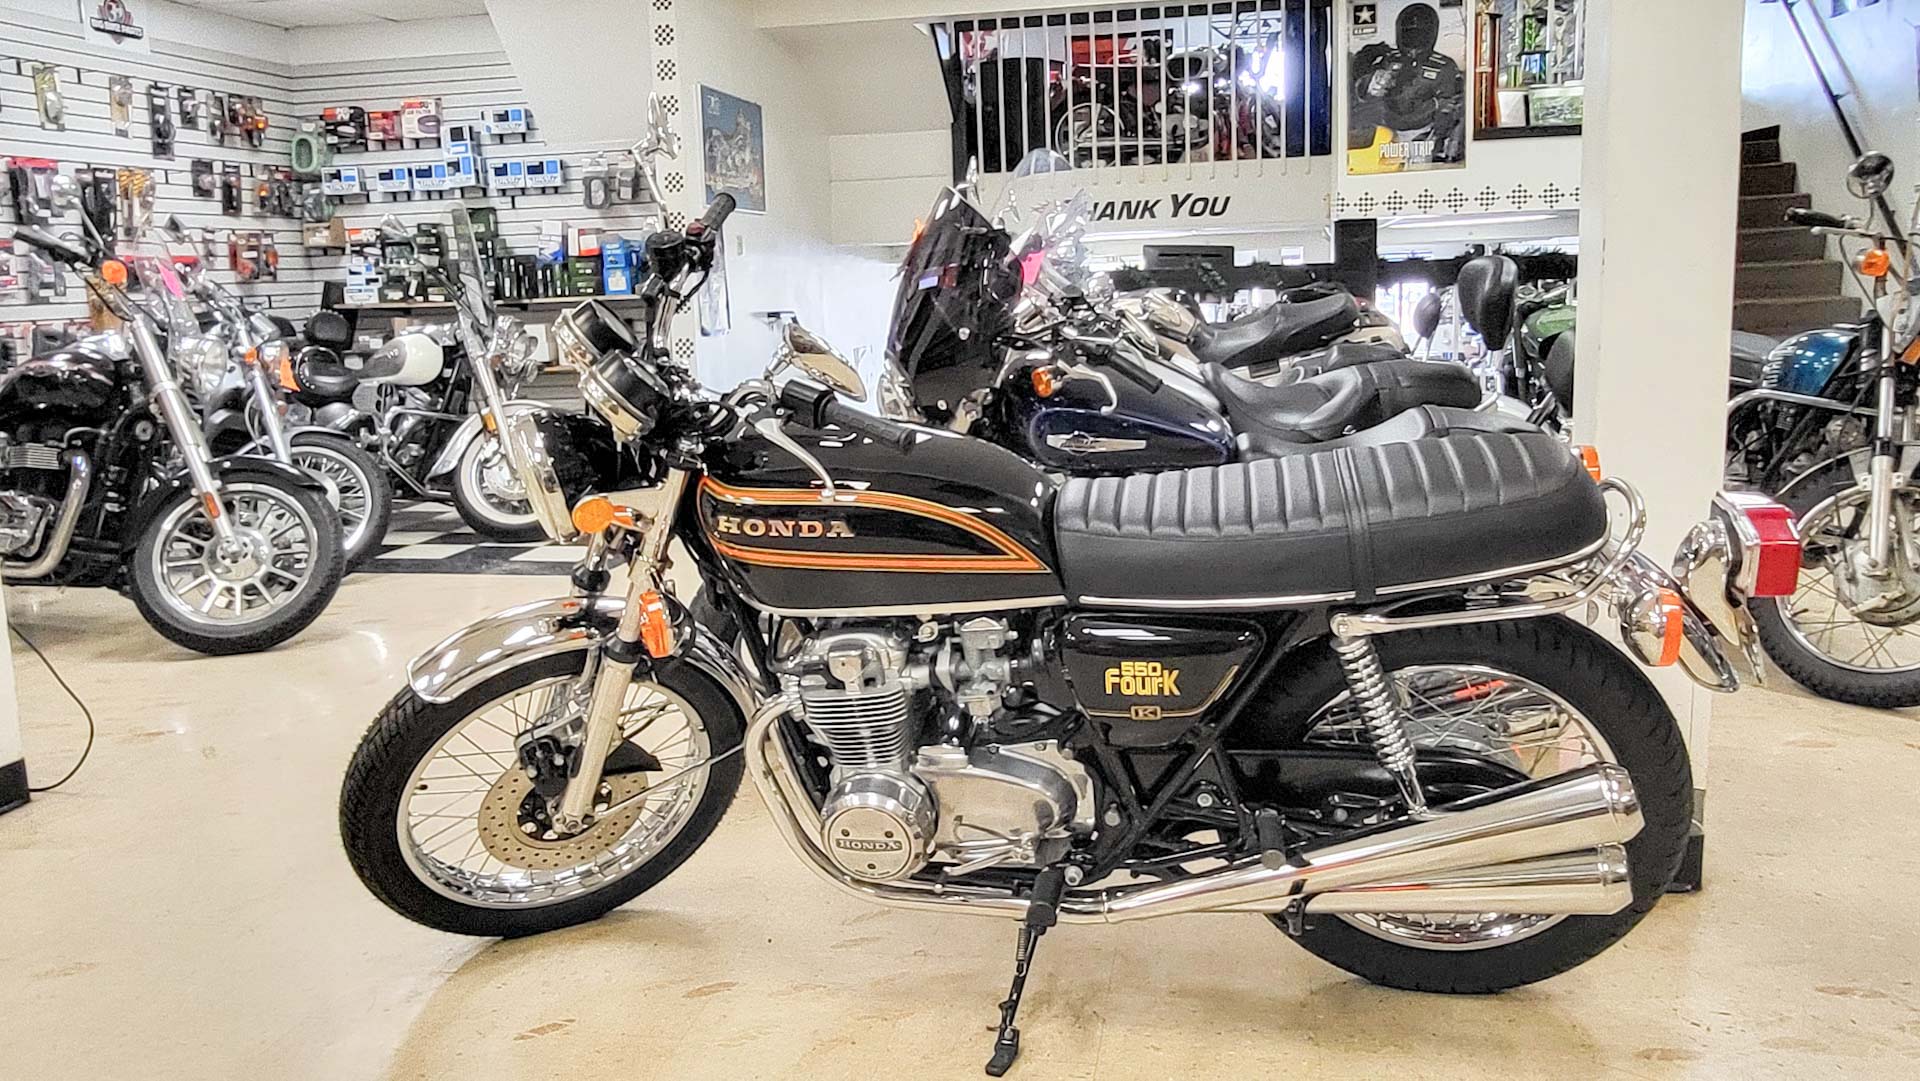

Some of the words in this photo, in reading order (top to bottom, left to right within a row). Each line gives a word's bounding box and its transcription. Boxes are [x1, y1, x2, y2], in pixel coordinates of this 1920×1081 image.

[1379, 142, 1410, 159] POWER
[1413, 140, 1435, 157] TRIP
[717, 515, 856, 539] HONDA
[1120, 661, 1162, 677] 550
[839, 839, 900, 850] HONDA
